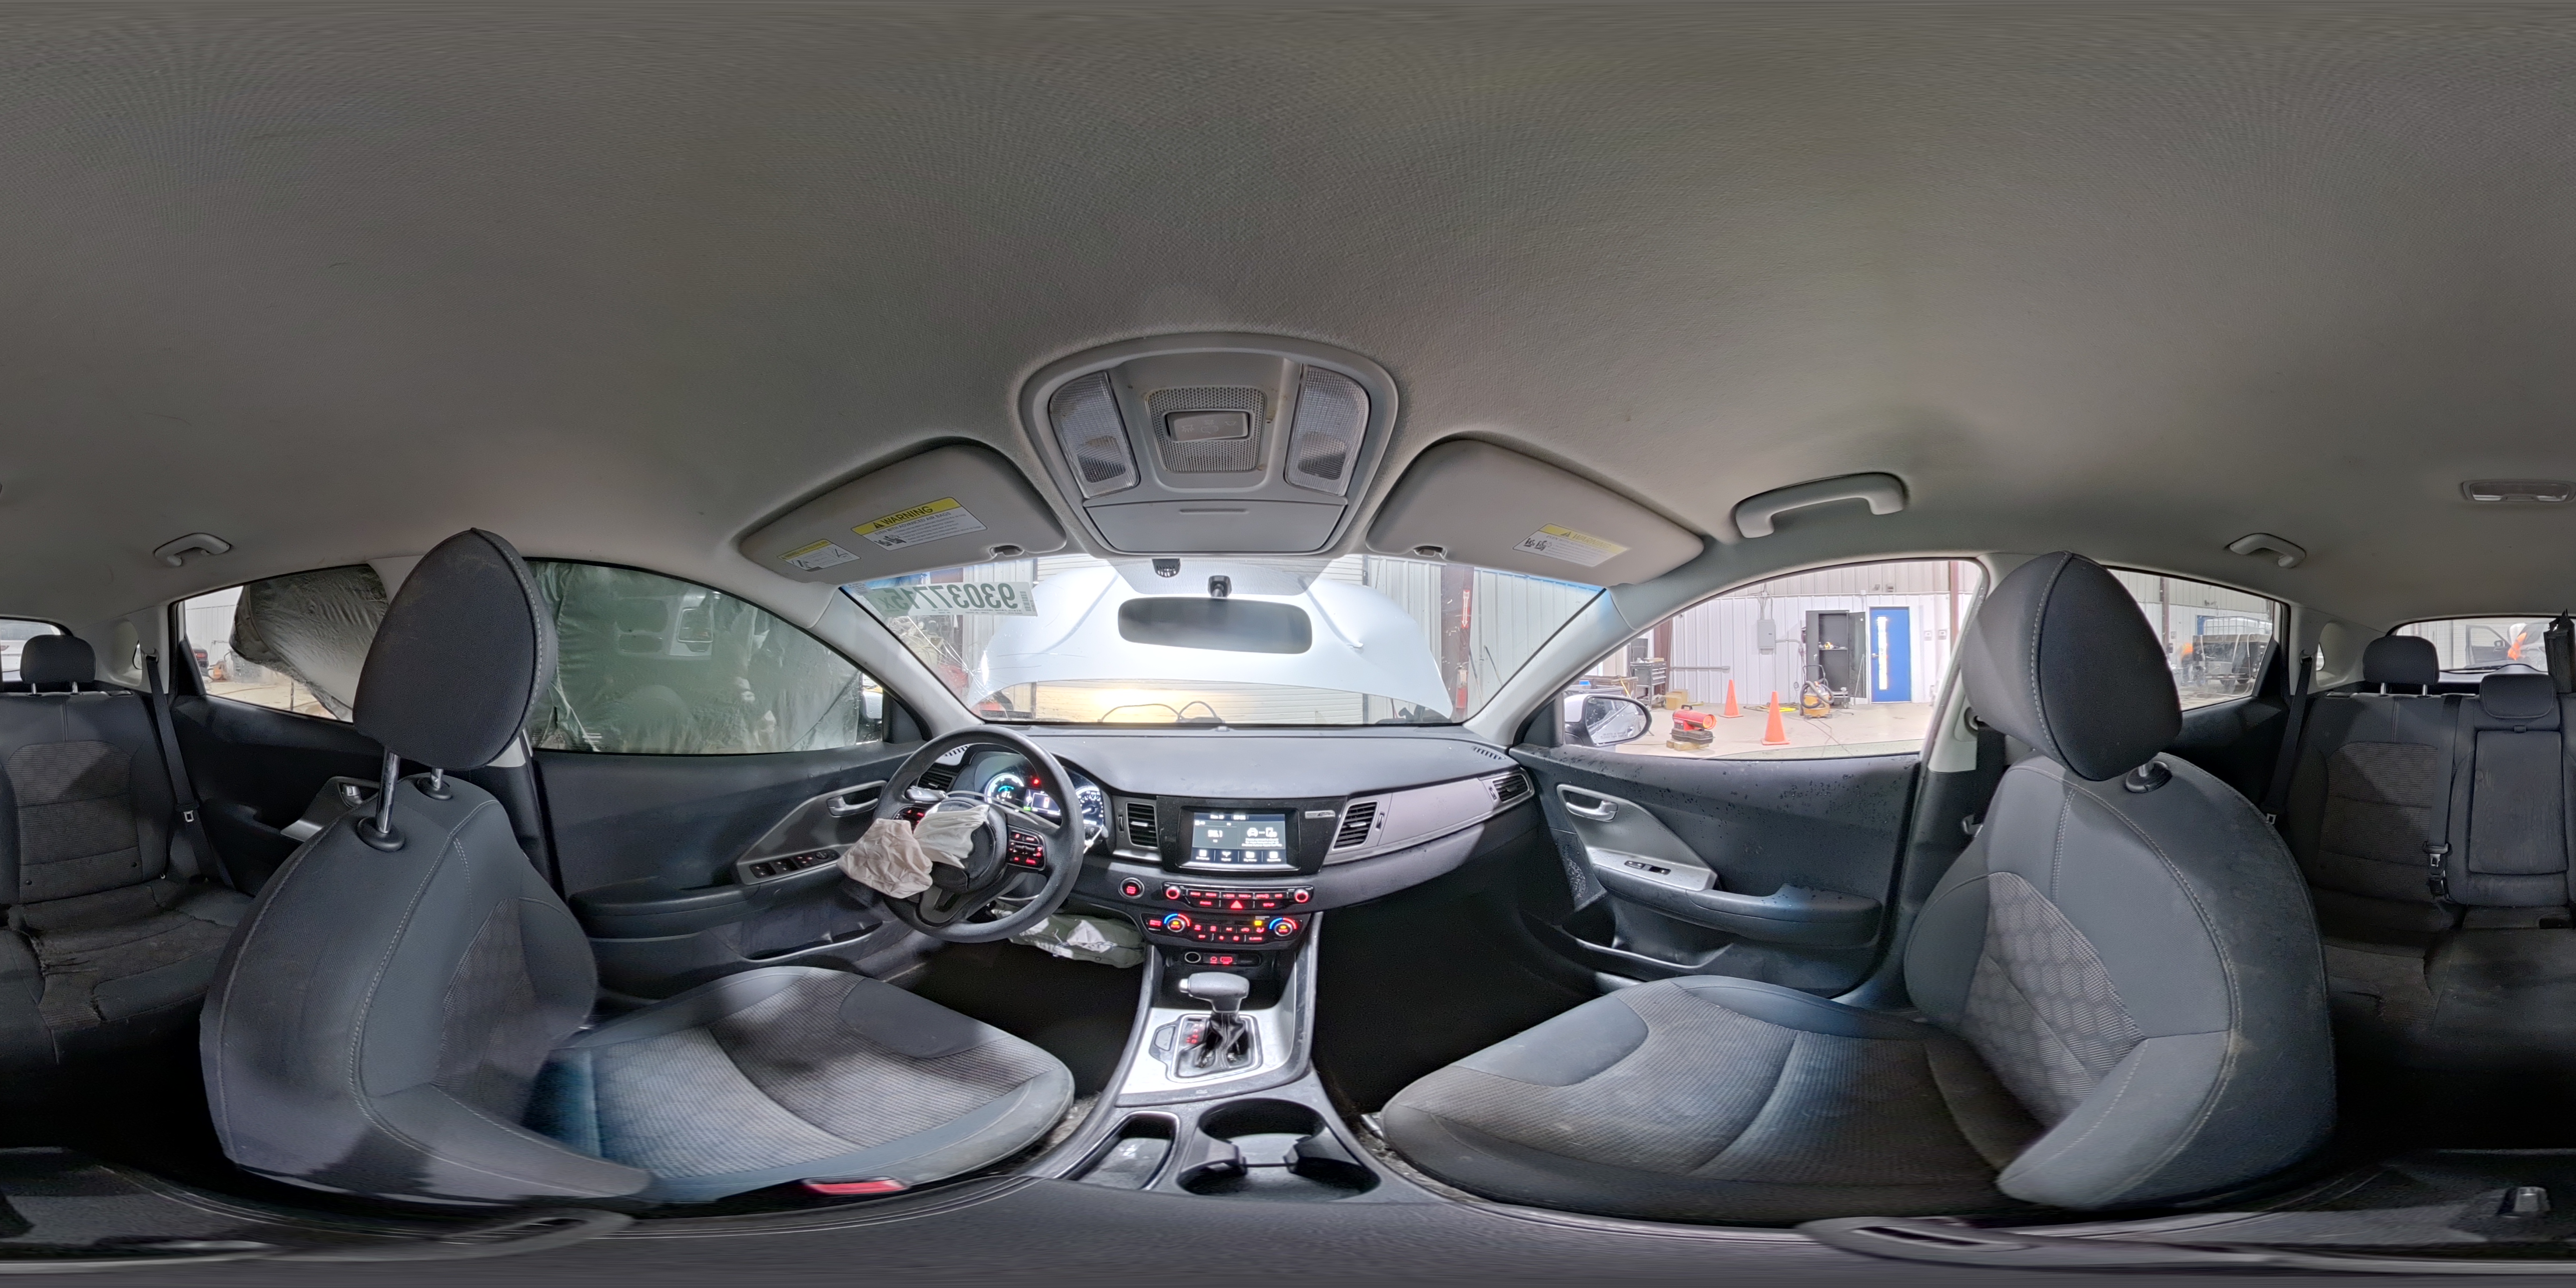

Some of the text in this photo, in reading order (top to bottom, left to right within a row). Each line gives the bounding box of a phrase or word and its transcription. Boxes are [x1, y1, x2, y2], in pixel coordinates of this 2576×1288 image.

[880, 506, 933, 525] WARNING
[899, 519, 926, 528] ADVANCED
[1572, 534, 1611, 549] WARNING
